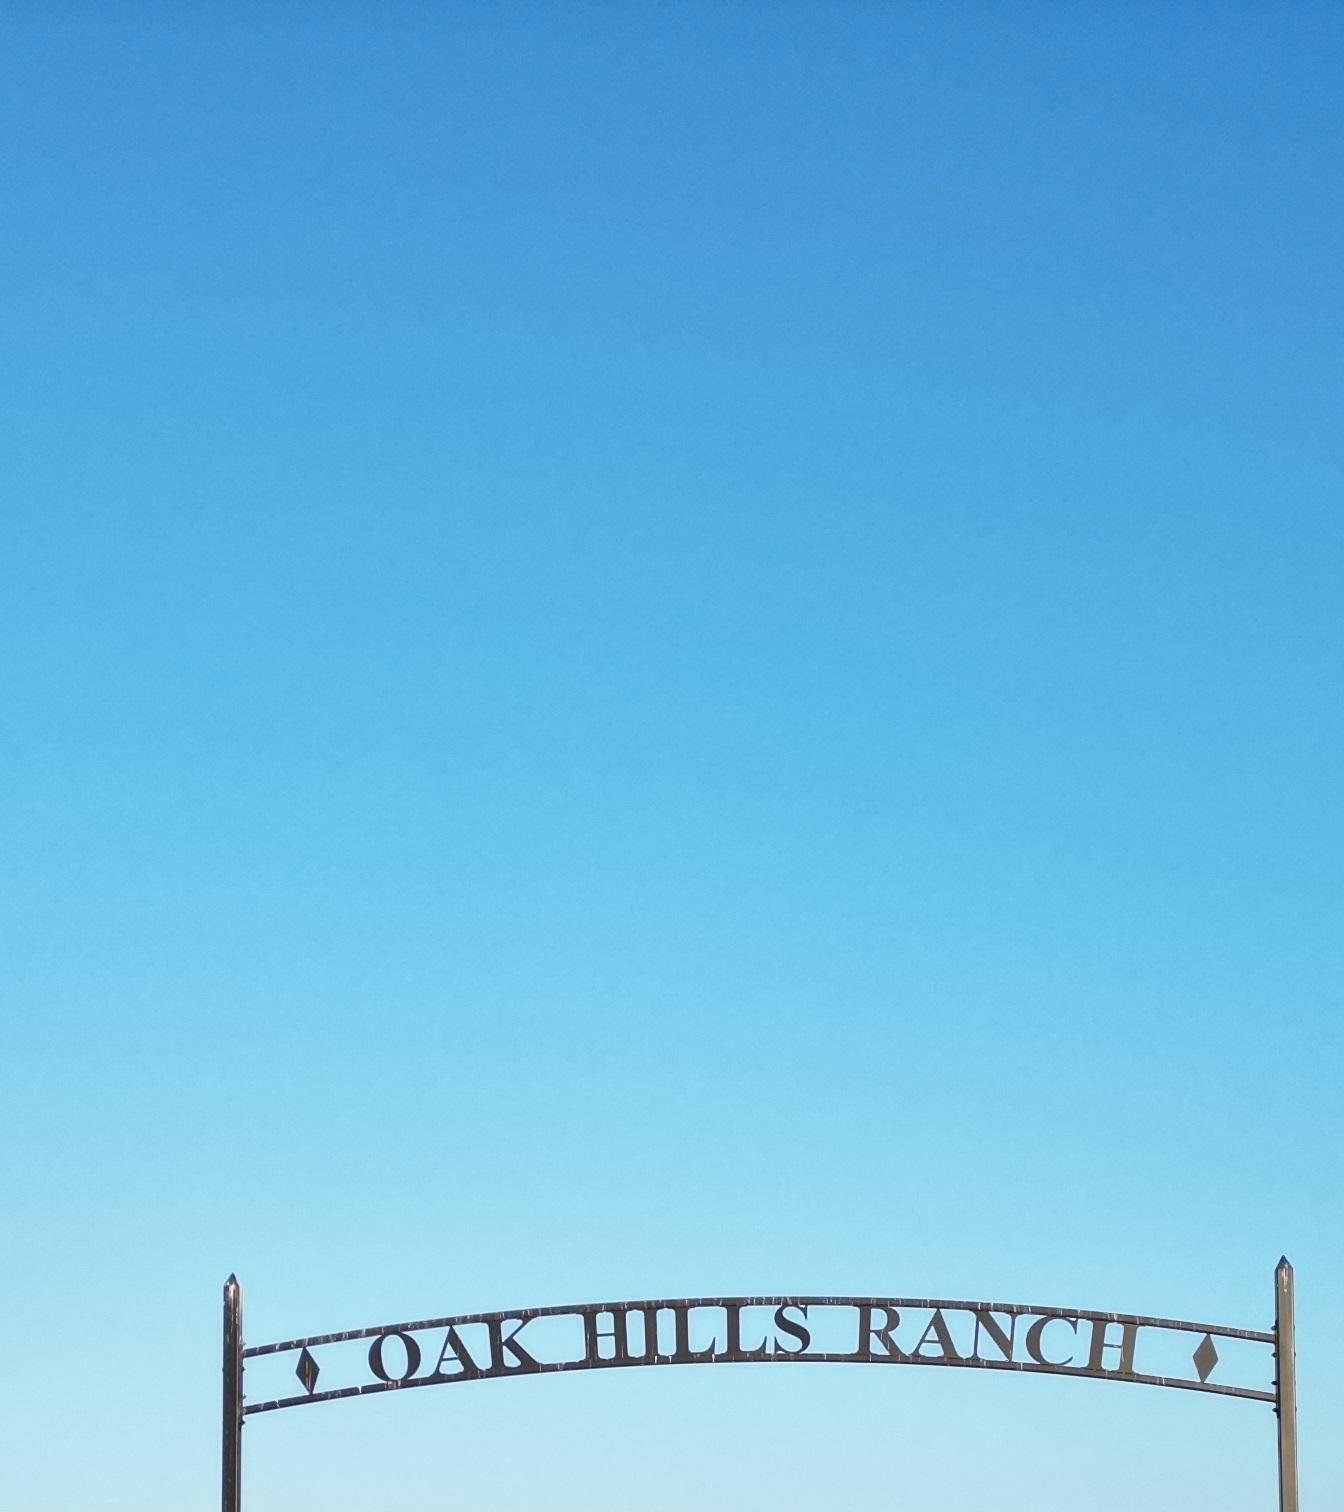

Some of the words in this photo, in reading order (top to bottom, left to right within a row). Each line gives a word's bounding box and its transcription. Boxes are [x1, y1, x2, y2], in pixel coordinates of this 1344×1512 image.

[368, 1316, 542, 1382] OAK
[582, 1304, 811, 1362] HILLS
[854, 1304, 1140, 1375] RANCH
